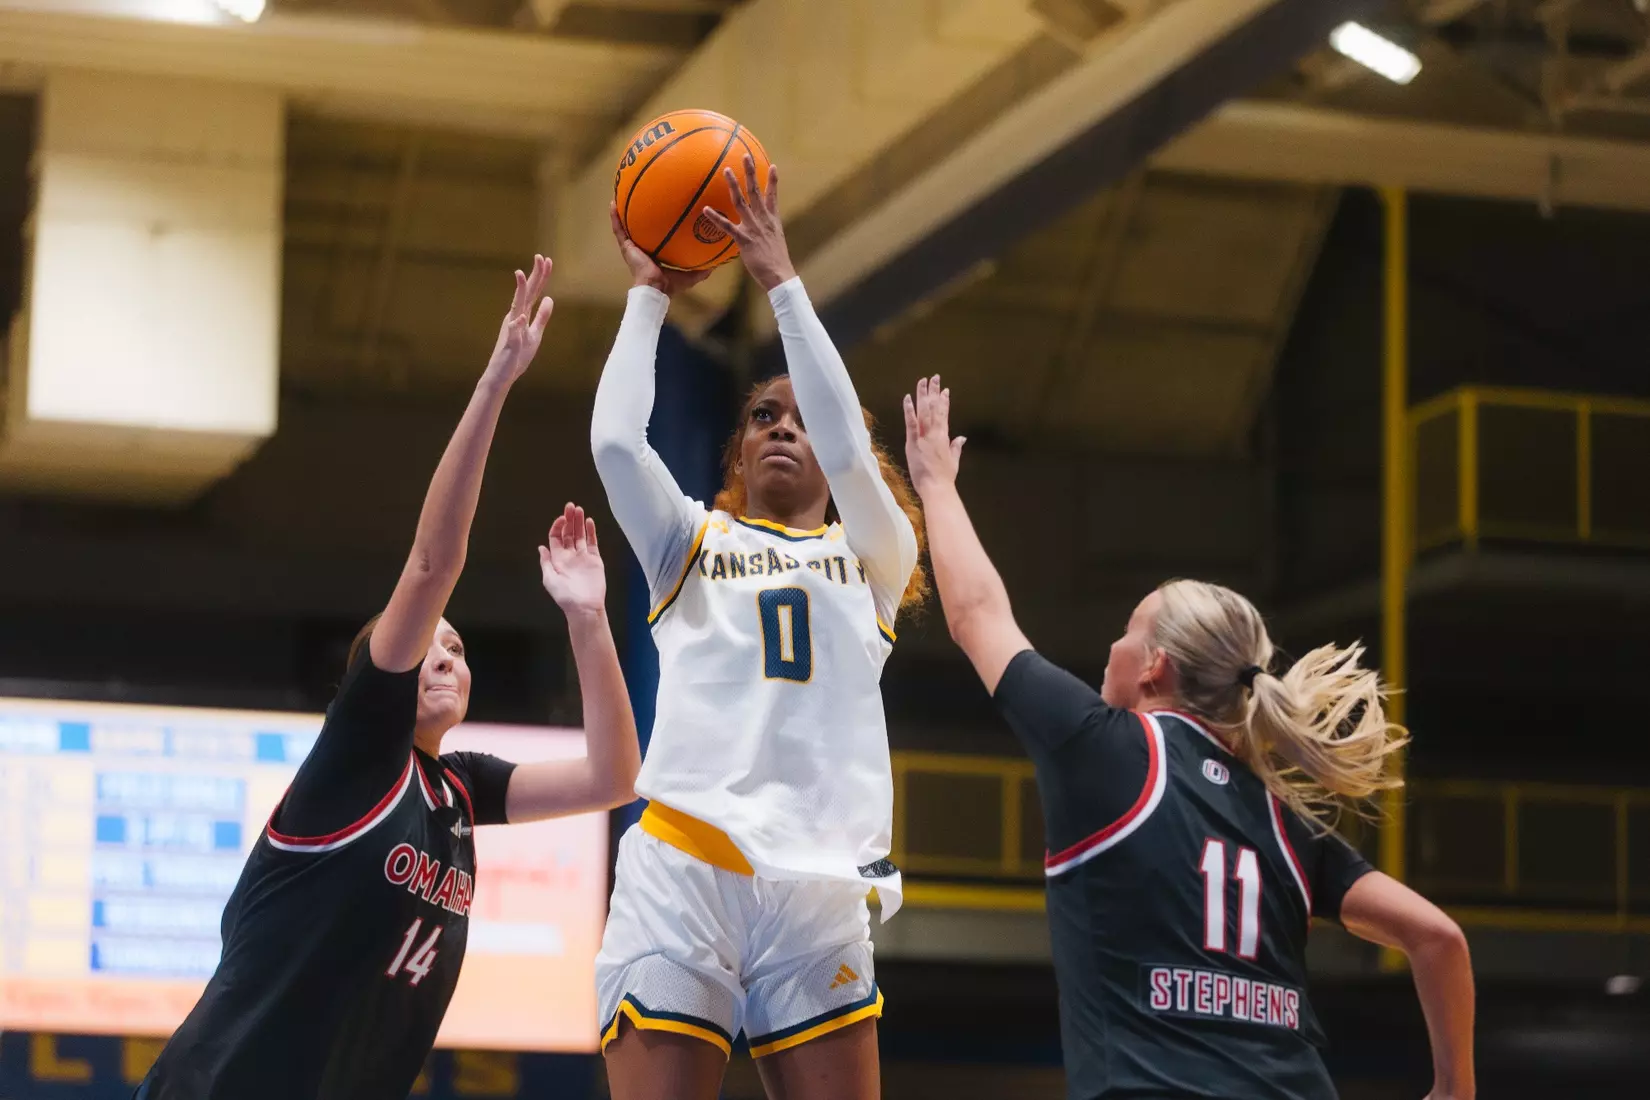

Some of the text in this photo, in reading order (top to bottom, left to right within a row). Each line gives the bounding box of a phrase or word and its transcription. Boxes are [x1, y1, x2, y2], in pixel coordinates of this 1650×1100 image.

[614, 120, 676, 198] Wilso
[698, 546, 801, 582] KANSAS
[756, 584, 815, 685] 0
[384, 842, 474, 918] OMAHA
[1199, 836, 1262, 961] 11
[384, 915, 444, 988] 14
[1150, 967, 1300, 1031] STEPHENS
